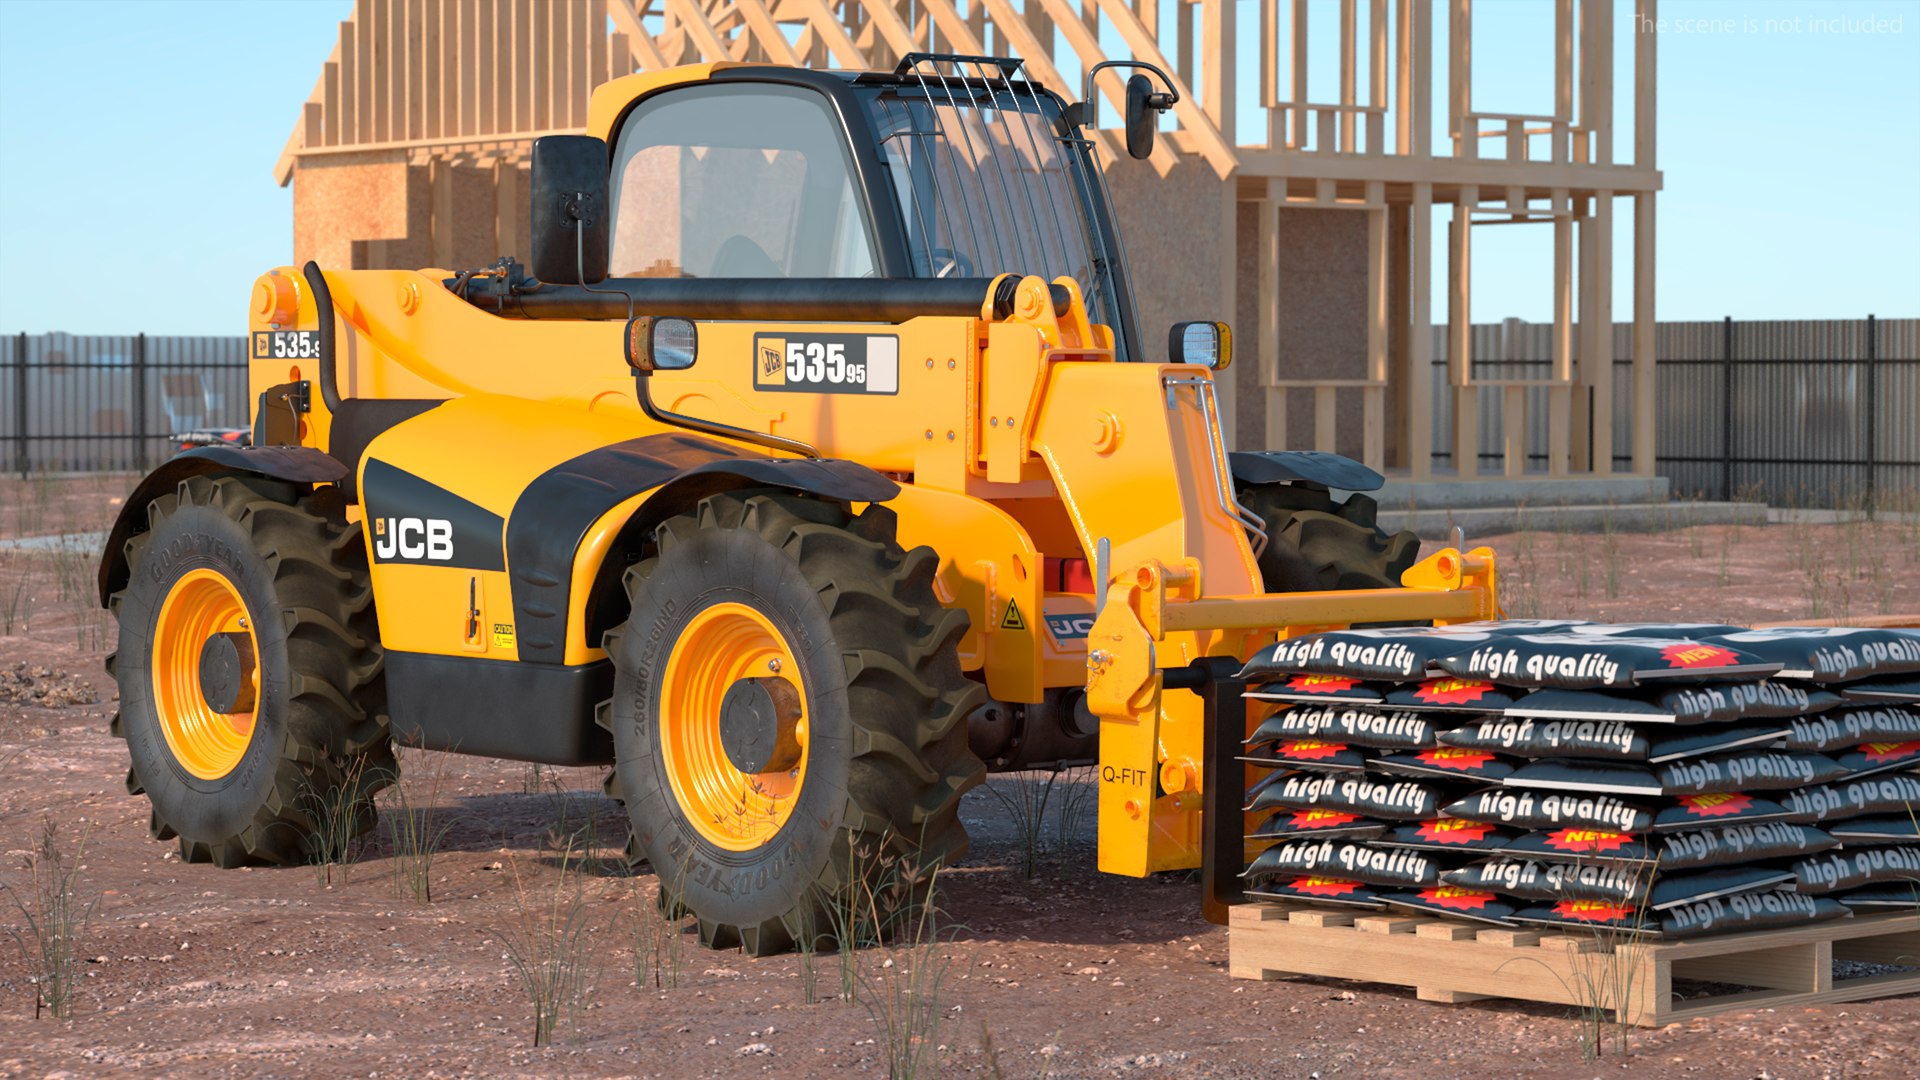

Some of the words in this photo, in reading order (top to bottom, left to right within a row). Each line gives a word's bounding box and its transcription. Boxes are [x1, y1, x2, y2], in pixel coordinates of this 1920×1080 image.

[764, 350, 782, 373] JCB
[376, 517, 454, 561] JCB
[1272, 637, 1325, 667] high
[1330, 641, 1416, 676] quality
[1469, 646, 1519, 679] high
[1526, 652, 1619, 685] quality
[1677, 646, 1720, 665] NEW
[1815, 644, 1858, 678] high
[1678, 688, 1726, 719] high
[1731, 681, 1809, 712] quality
[1282, 706, 1336, 735] high
[1341, 710, 1426, 745] quality
[1477, 719, 1535, 747] high
[1542, 721, 1635, 754] quality
[1791, 714, 1839, 748] high
[1102, 765, 1147, 787] Q-FIT
[1668, 759, 1721, 790] high
[1727, 753, 1815, 785] quality
[1283, 774, 1336, 804] high
[1341, 779, 1427, 815] quality
[1478, 790, 1534, 822] high
[1541, 795, 1638, 832] quality
[1790, 785, 1841, 819] high
[1664, 829, 1718, 861] high
[1722, 821, 1807, 853] quality
[1278, 839, 1334, 869] high
[1339, 844, 1427, 883] quality
[1480, 858, 1538, 890] high
[1546, 863, 1637, 900] quality
[1802, 854, 1850, 888] high
[1668, 897, 1724, 929] high
[1730, 889, 1817, 921] quality
